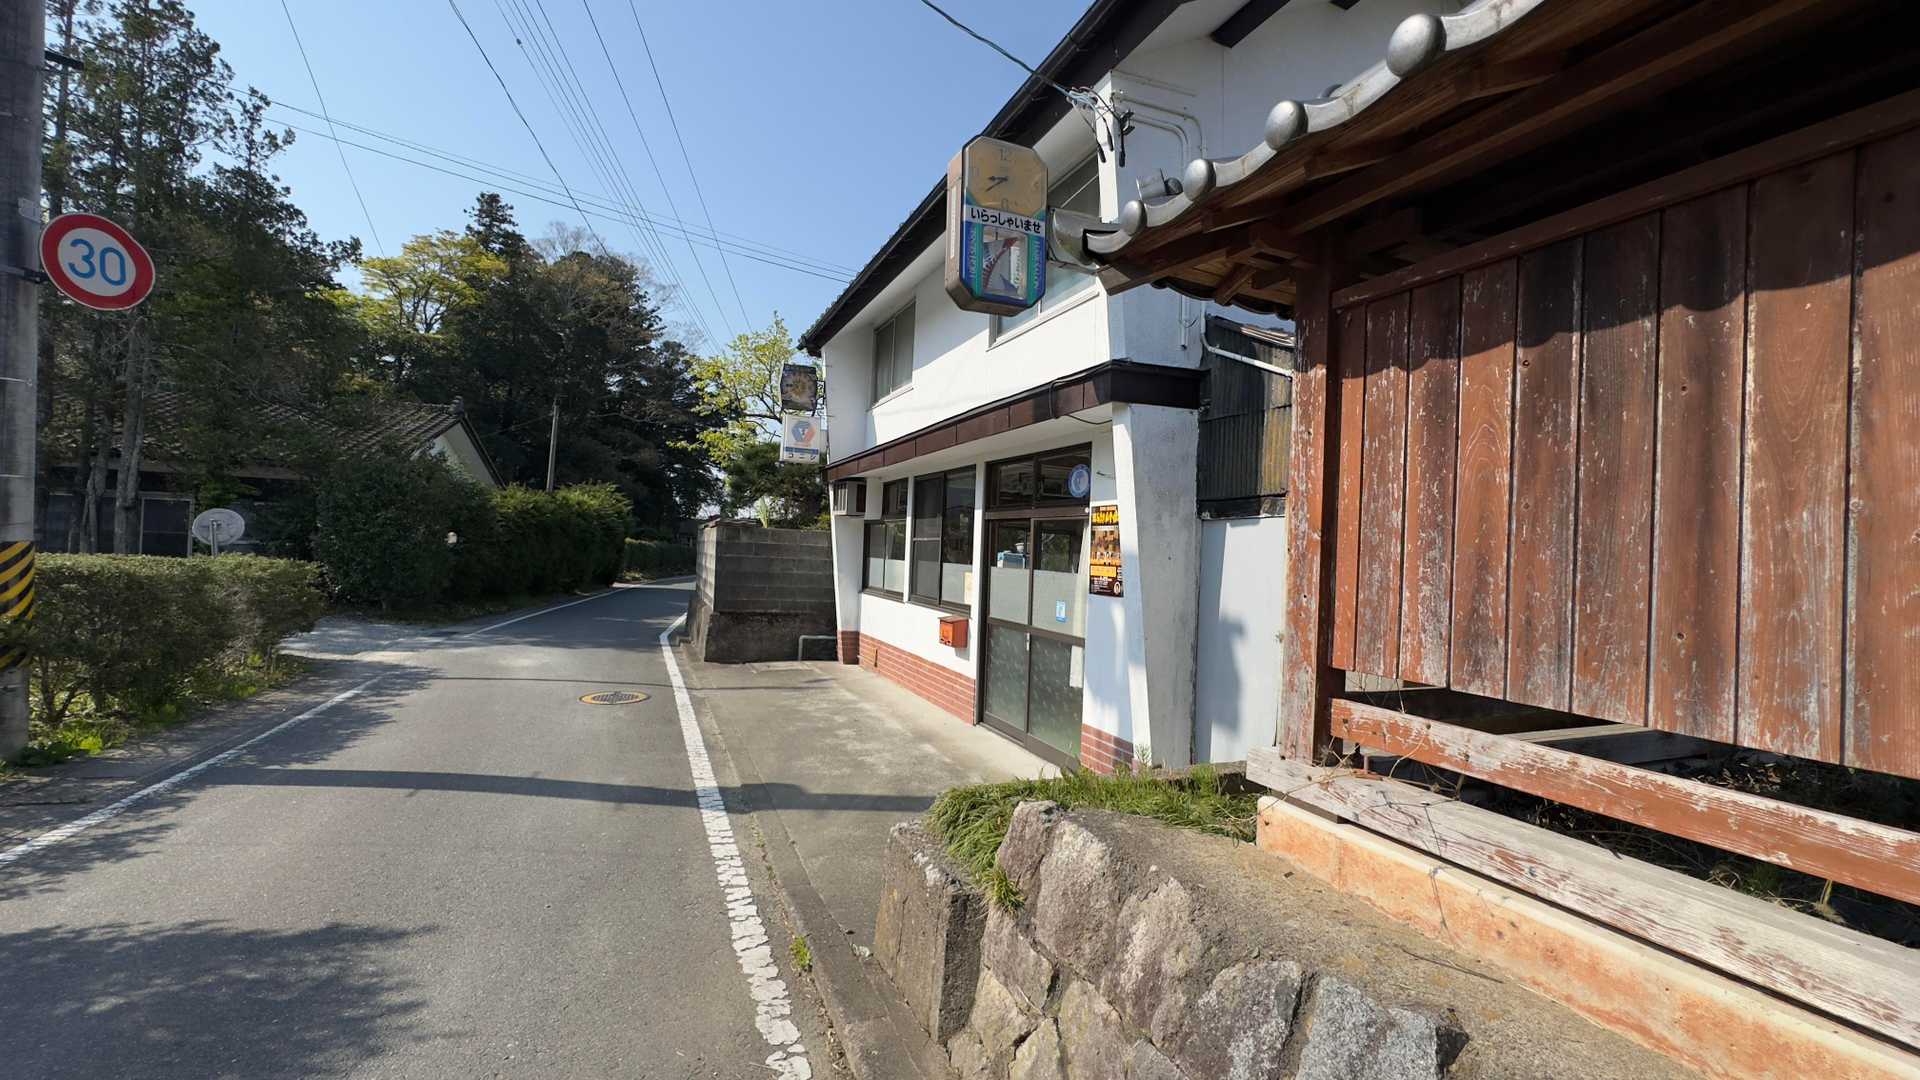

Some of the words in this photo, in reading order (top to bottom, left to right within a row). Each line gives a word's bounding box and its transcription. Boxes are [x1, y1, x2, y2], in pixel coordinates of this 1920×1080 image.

[971, 207, 1041, 234] いらっしゃいませ
[69, 238, 127, 286] 30
